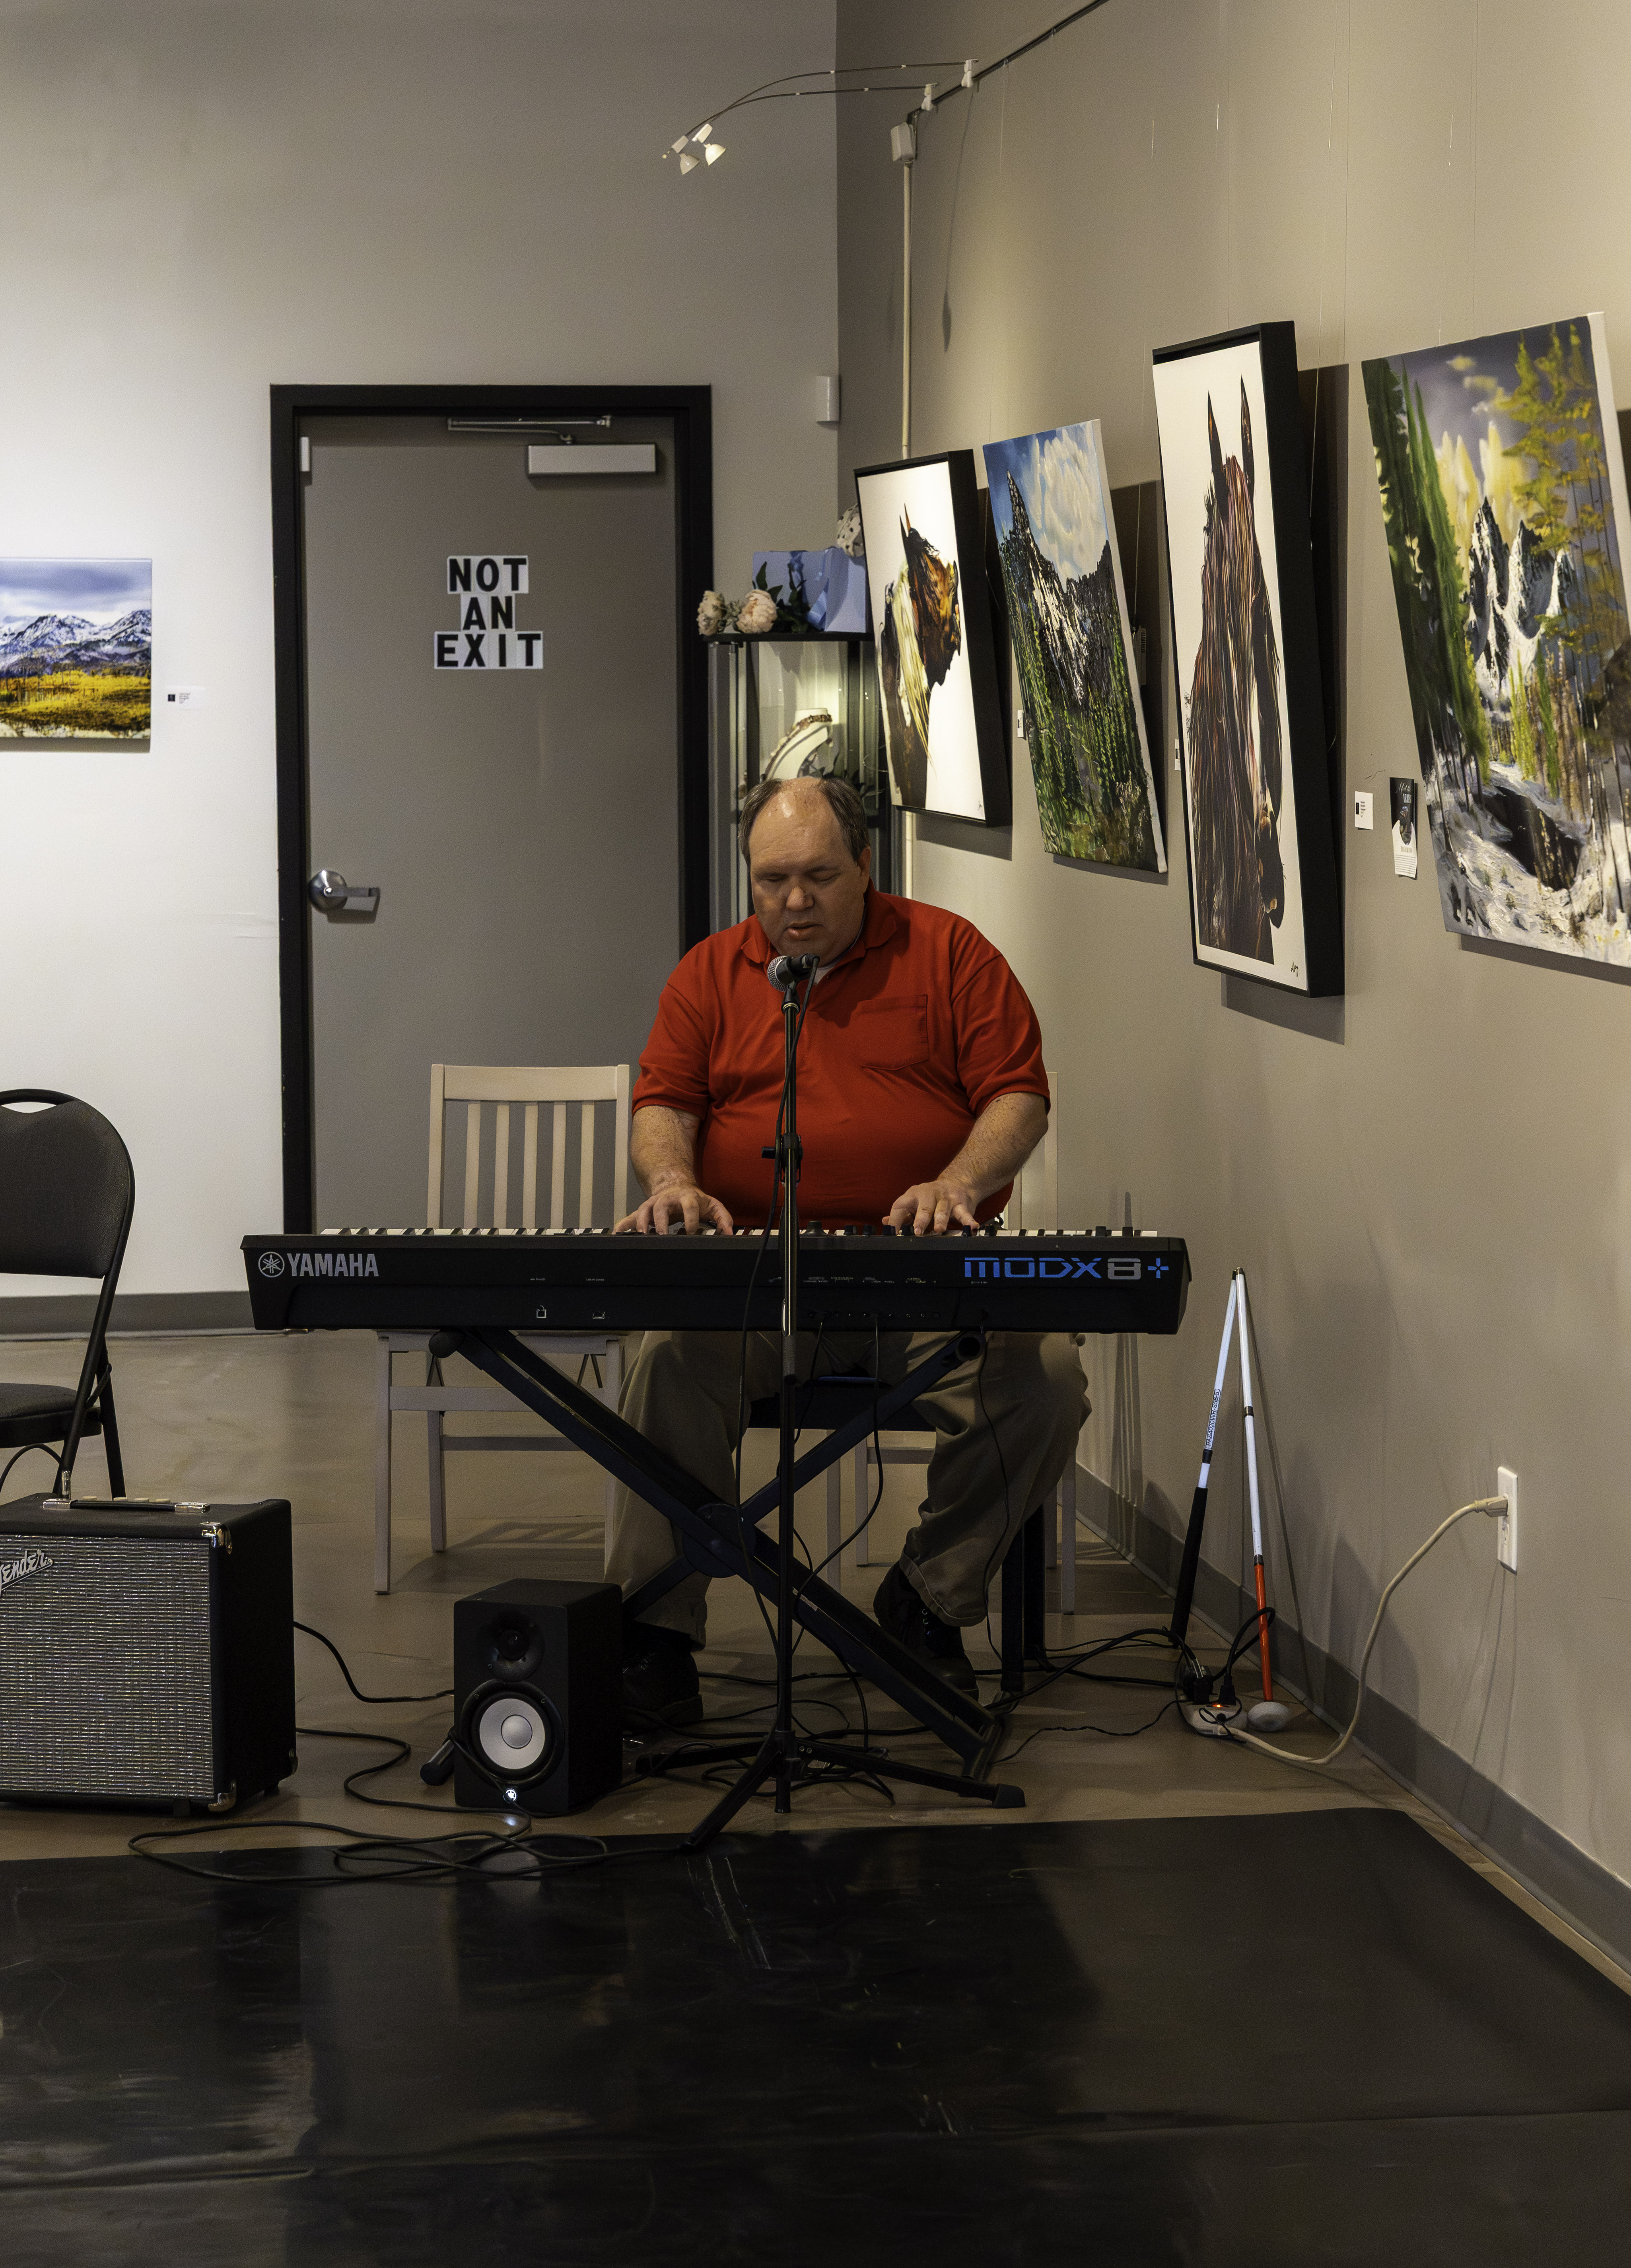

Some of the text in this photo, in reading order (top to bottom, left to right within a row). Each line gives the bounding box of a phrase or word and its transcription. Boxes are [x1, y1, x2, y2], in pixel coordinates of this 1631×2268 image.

[449, 558, 527, 592] NOT
[462, 596, 513, 631] AN
[437, 634, 541, 667] EXIT
[287, 1253, 379, 1277] YAMAHA
[0, 1549, 48, 1598] ender
